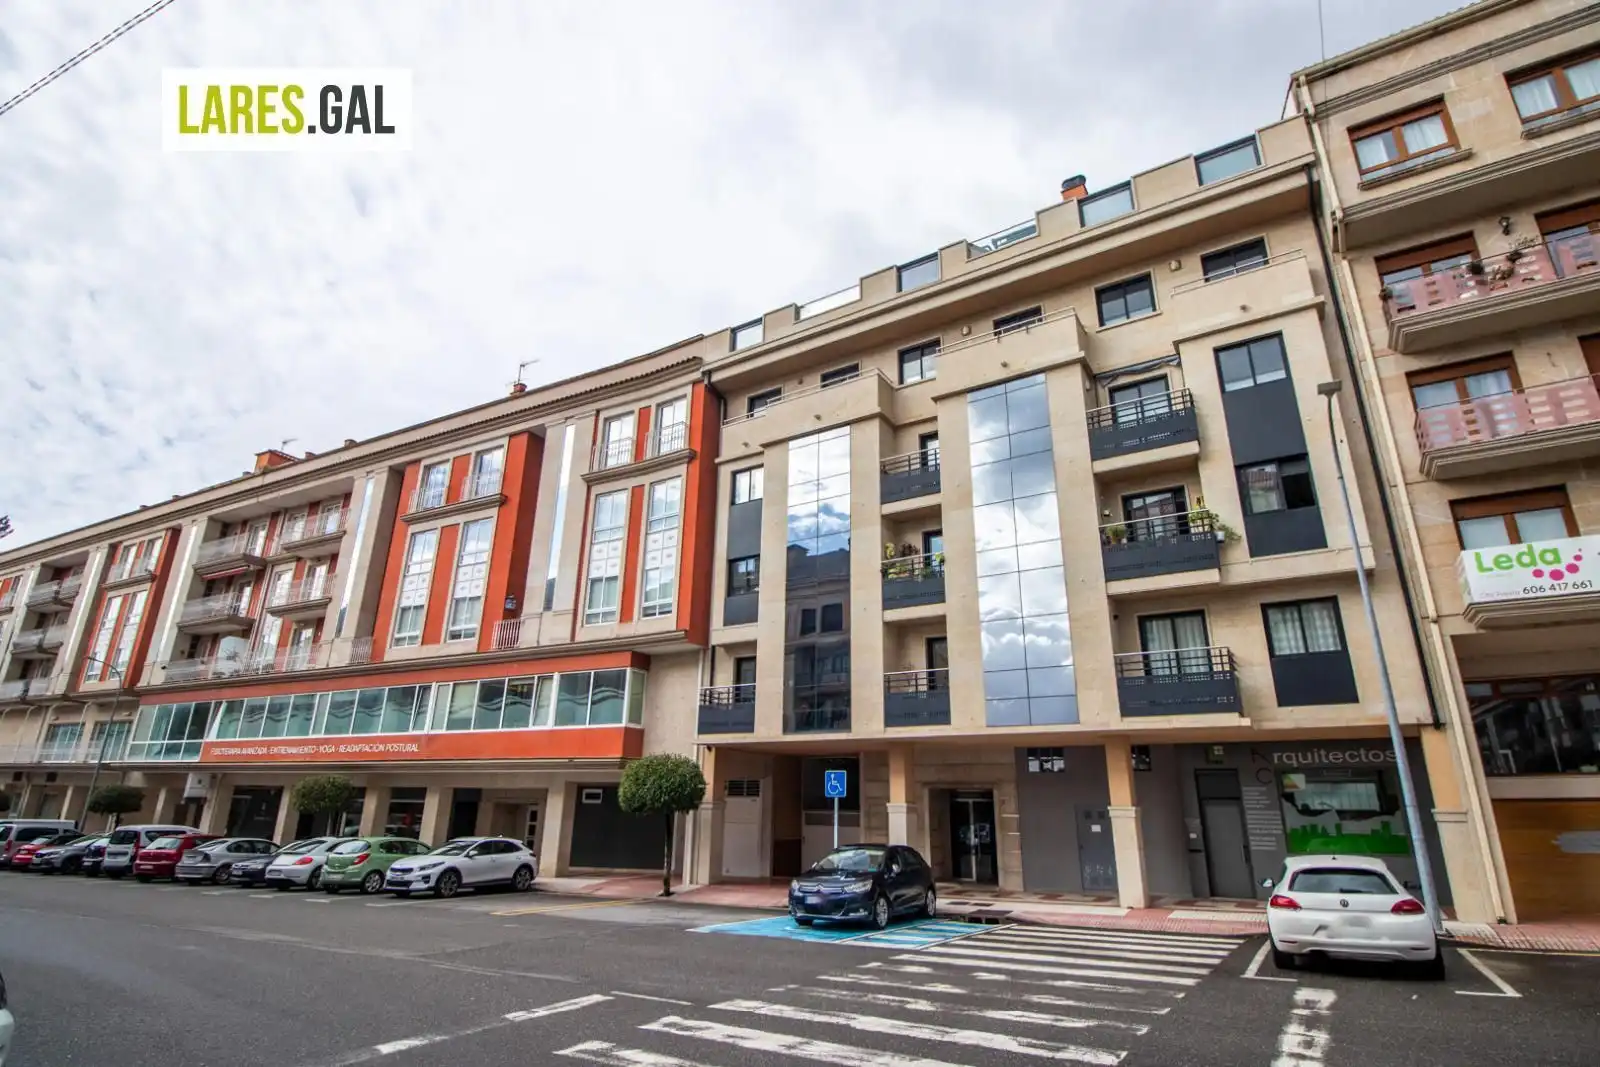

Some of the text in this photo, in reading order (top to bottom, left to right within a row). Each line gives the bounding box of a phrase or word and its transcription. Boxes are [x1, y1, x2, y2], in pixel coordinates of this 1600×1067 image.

[1474, 544, 1561, 573] Leda
[1522, 584, 1546, 595] 606
[1548, 582, 1569, 592] 417
[1572, 579, 1593, 590] 661
[319, 744, 335, 754] YOGA
[339, 742, 385, 753] READAPTACIÓN
[385, 743, 420, 753] POSTURAL
